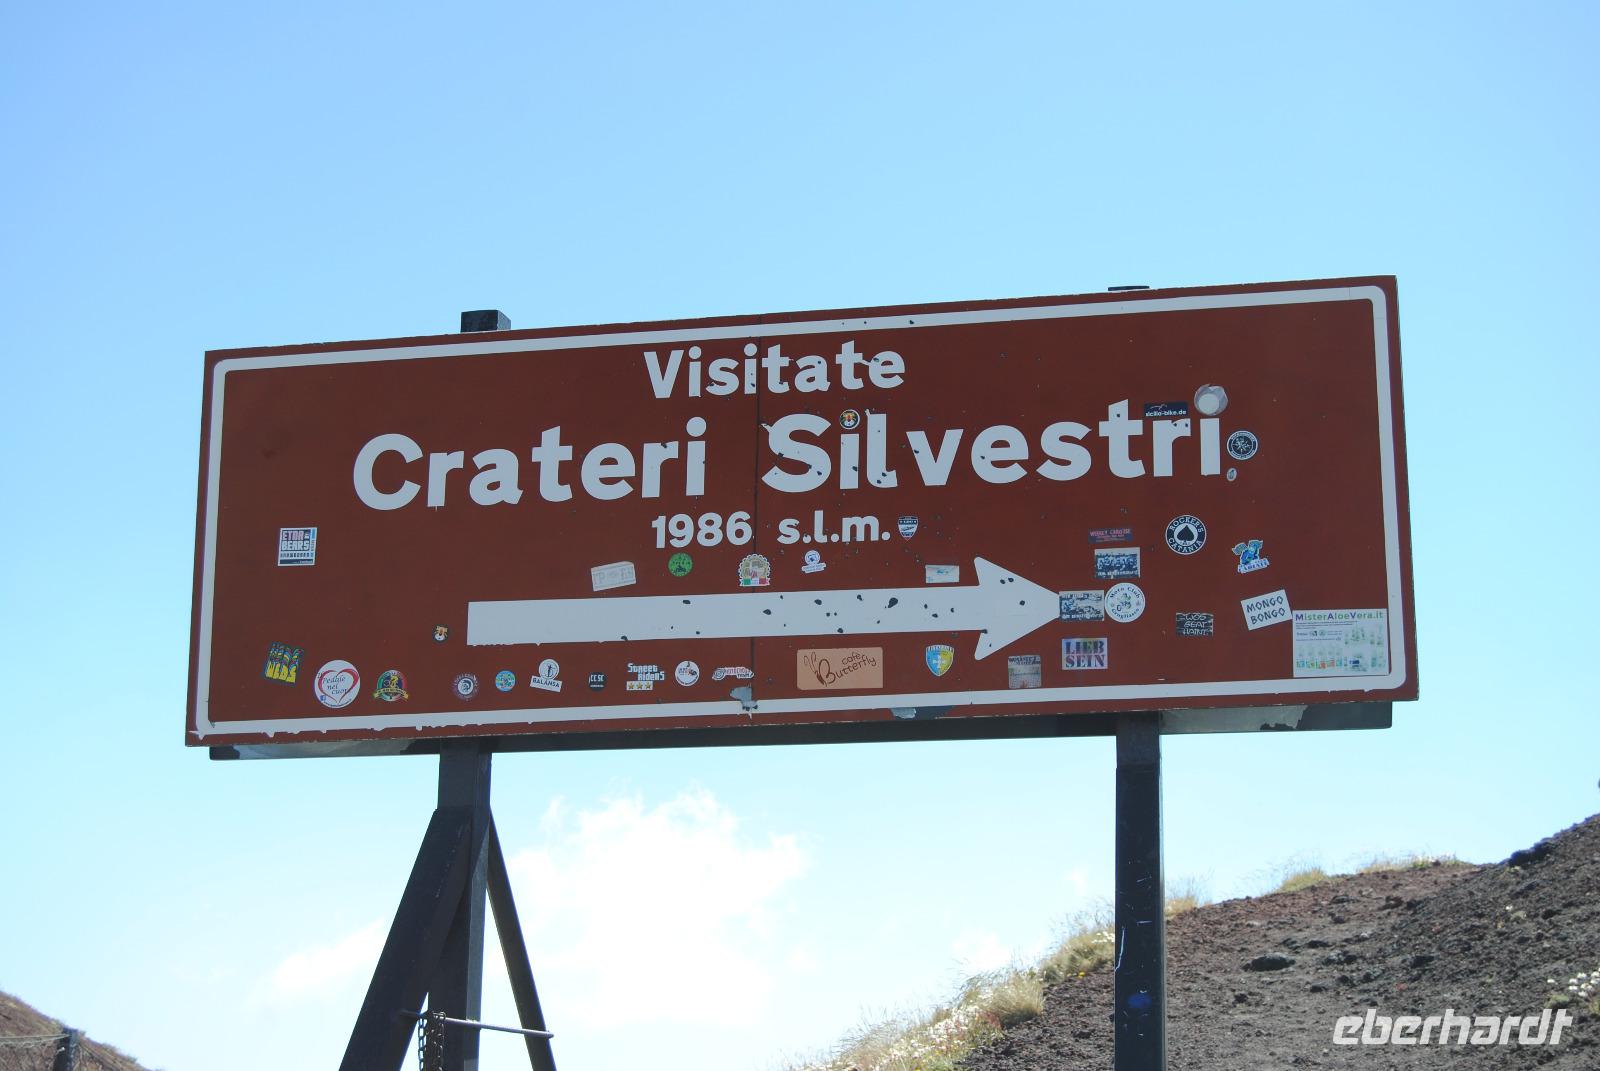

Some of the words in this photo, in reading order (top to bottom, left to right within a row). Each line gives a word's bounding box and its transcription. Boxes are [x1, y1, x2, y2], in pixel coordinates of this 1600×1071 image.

[644, 340, 906, 398] Visitate
[353, 417, 707, 510] Crateri
[760, 390, 1221, 492] Silvestri
[651, 511, 753, 549] 1986
[776, 509, 891, 544] s.l.m.
[1168, 537, 1203, 553] CATANIA
[1246, 595, 1284, 613] MONGO
[1250, 607, 1286, 625] BONGO
[1295, 610, 1384, 621] MisterAloeVera.it
[1065, 641, 1105, 655] LIEB
[818, 654, 877, 686] Butterfly
[1065, 654, 1105, 668] SEIN
